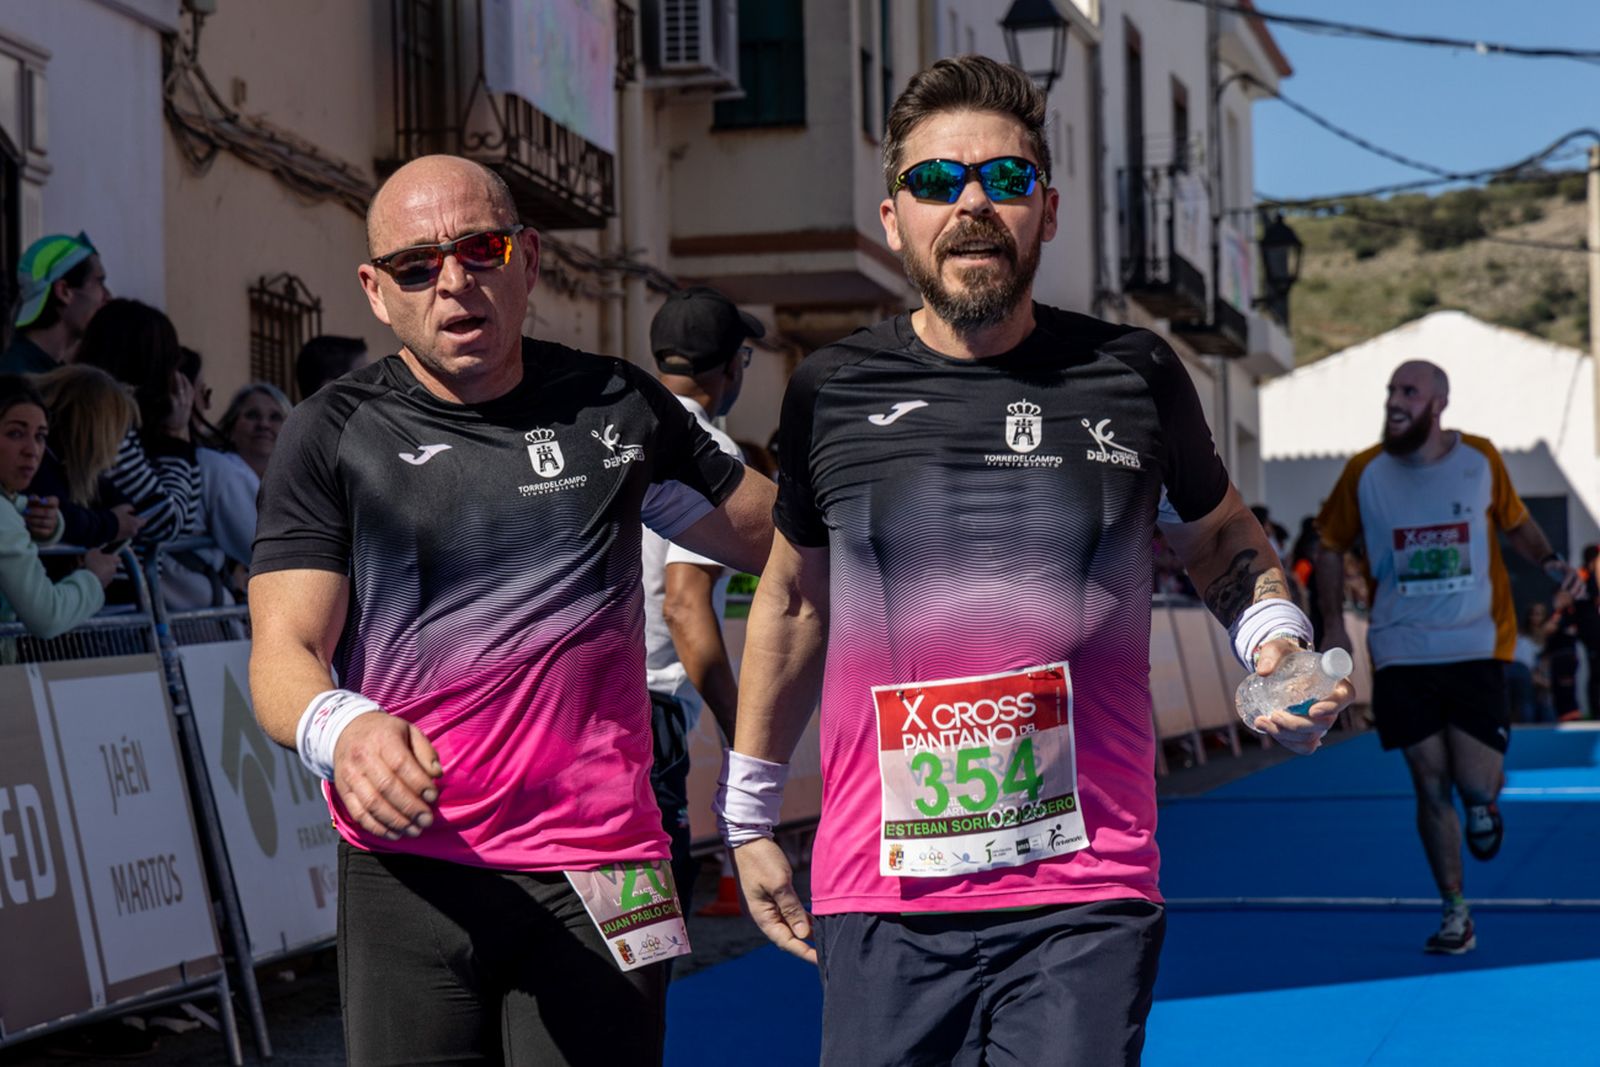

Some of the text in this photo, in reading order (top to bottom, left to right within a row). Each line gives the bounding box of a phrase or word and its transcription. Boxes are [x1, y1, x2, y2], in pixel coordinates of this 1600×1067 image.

[984, 454, 1063, 464] TORREDELCAMPO
[518, 474, 588, 494] TORREDELCAMPO
[901, 694, 928, 732] X
[931, 692, 1037, 730] CROSS
[902, 722, 1017, 757] PANTANO
[99, 735, 151, 815] JAÉN
[911, 736, 1044, 817] 354
[886, 821, 948, 837] ESTEBAN
[952, 814, 998, 834] SORIA
[0, 784, 56, 908] ED
[110, 854, 183, 917] MARTOS
[602, 919, 631, 935] JUAN
[631, 906, 662, 924] PABLO
